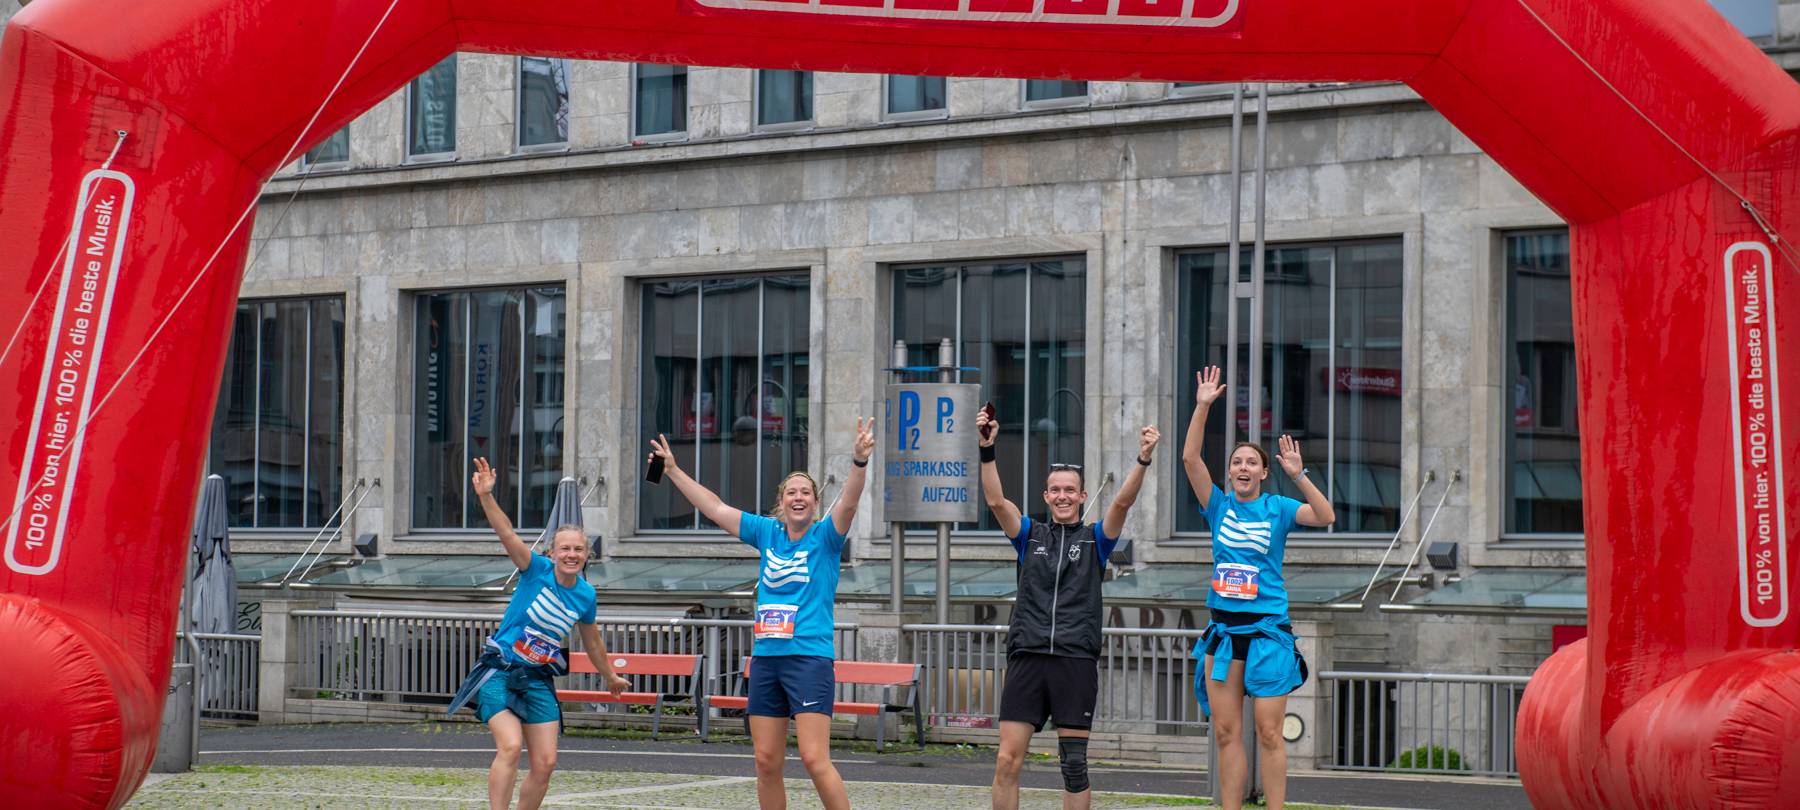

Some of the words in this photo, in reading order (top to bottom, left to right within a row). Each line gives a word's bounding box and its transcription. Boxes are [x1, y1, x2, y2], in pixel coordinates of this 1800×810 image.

[86, 195, 116, 256] Musik.
[74, 260, 101, 314] beste
[1742, 264, 1760, 324] Musik.
[68, 317, 89, 345] die
[1747, 328, 1763, 379] beste
[1748, 382, 1764, 409] die
[46, 410, 71, 450] hier.
[898, 390, 920, 451] P2
[936, 396, 954, 433] P2
[42, 455, 61, 487] von
[903, 460, 968, 477] SPARKASSE
[922, 486, 968, 503] AUFZUG
[1753, 470, 1769, 509] hier.
[1758, 513, 1770, 545] von
[528, 652, 540, 662] EVA
